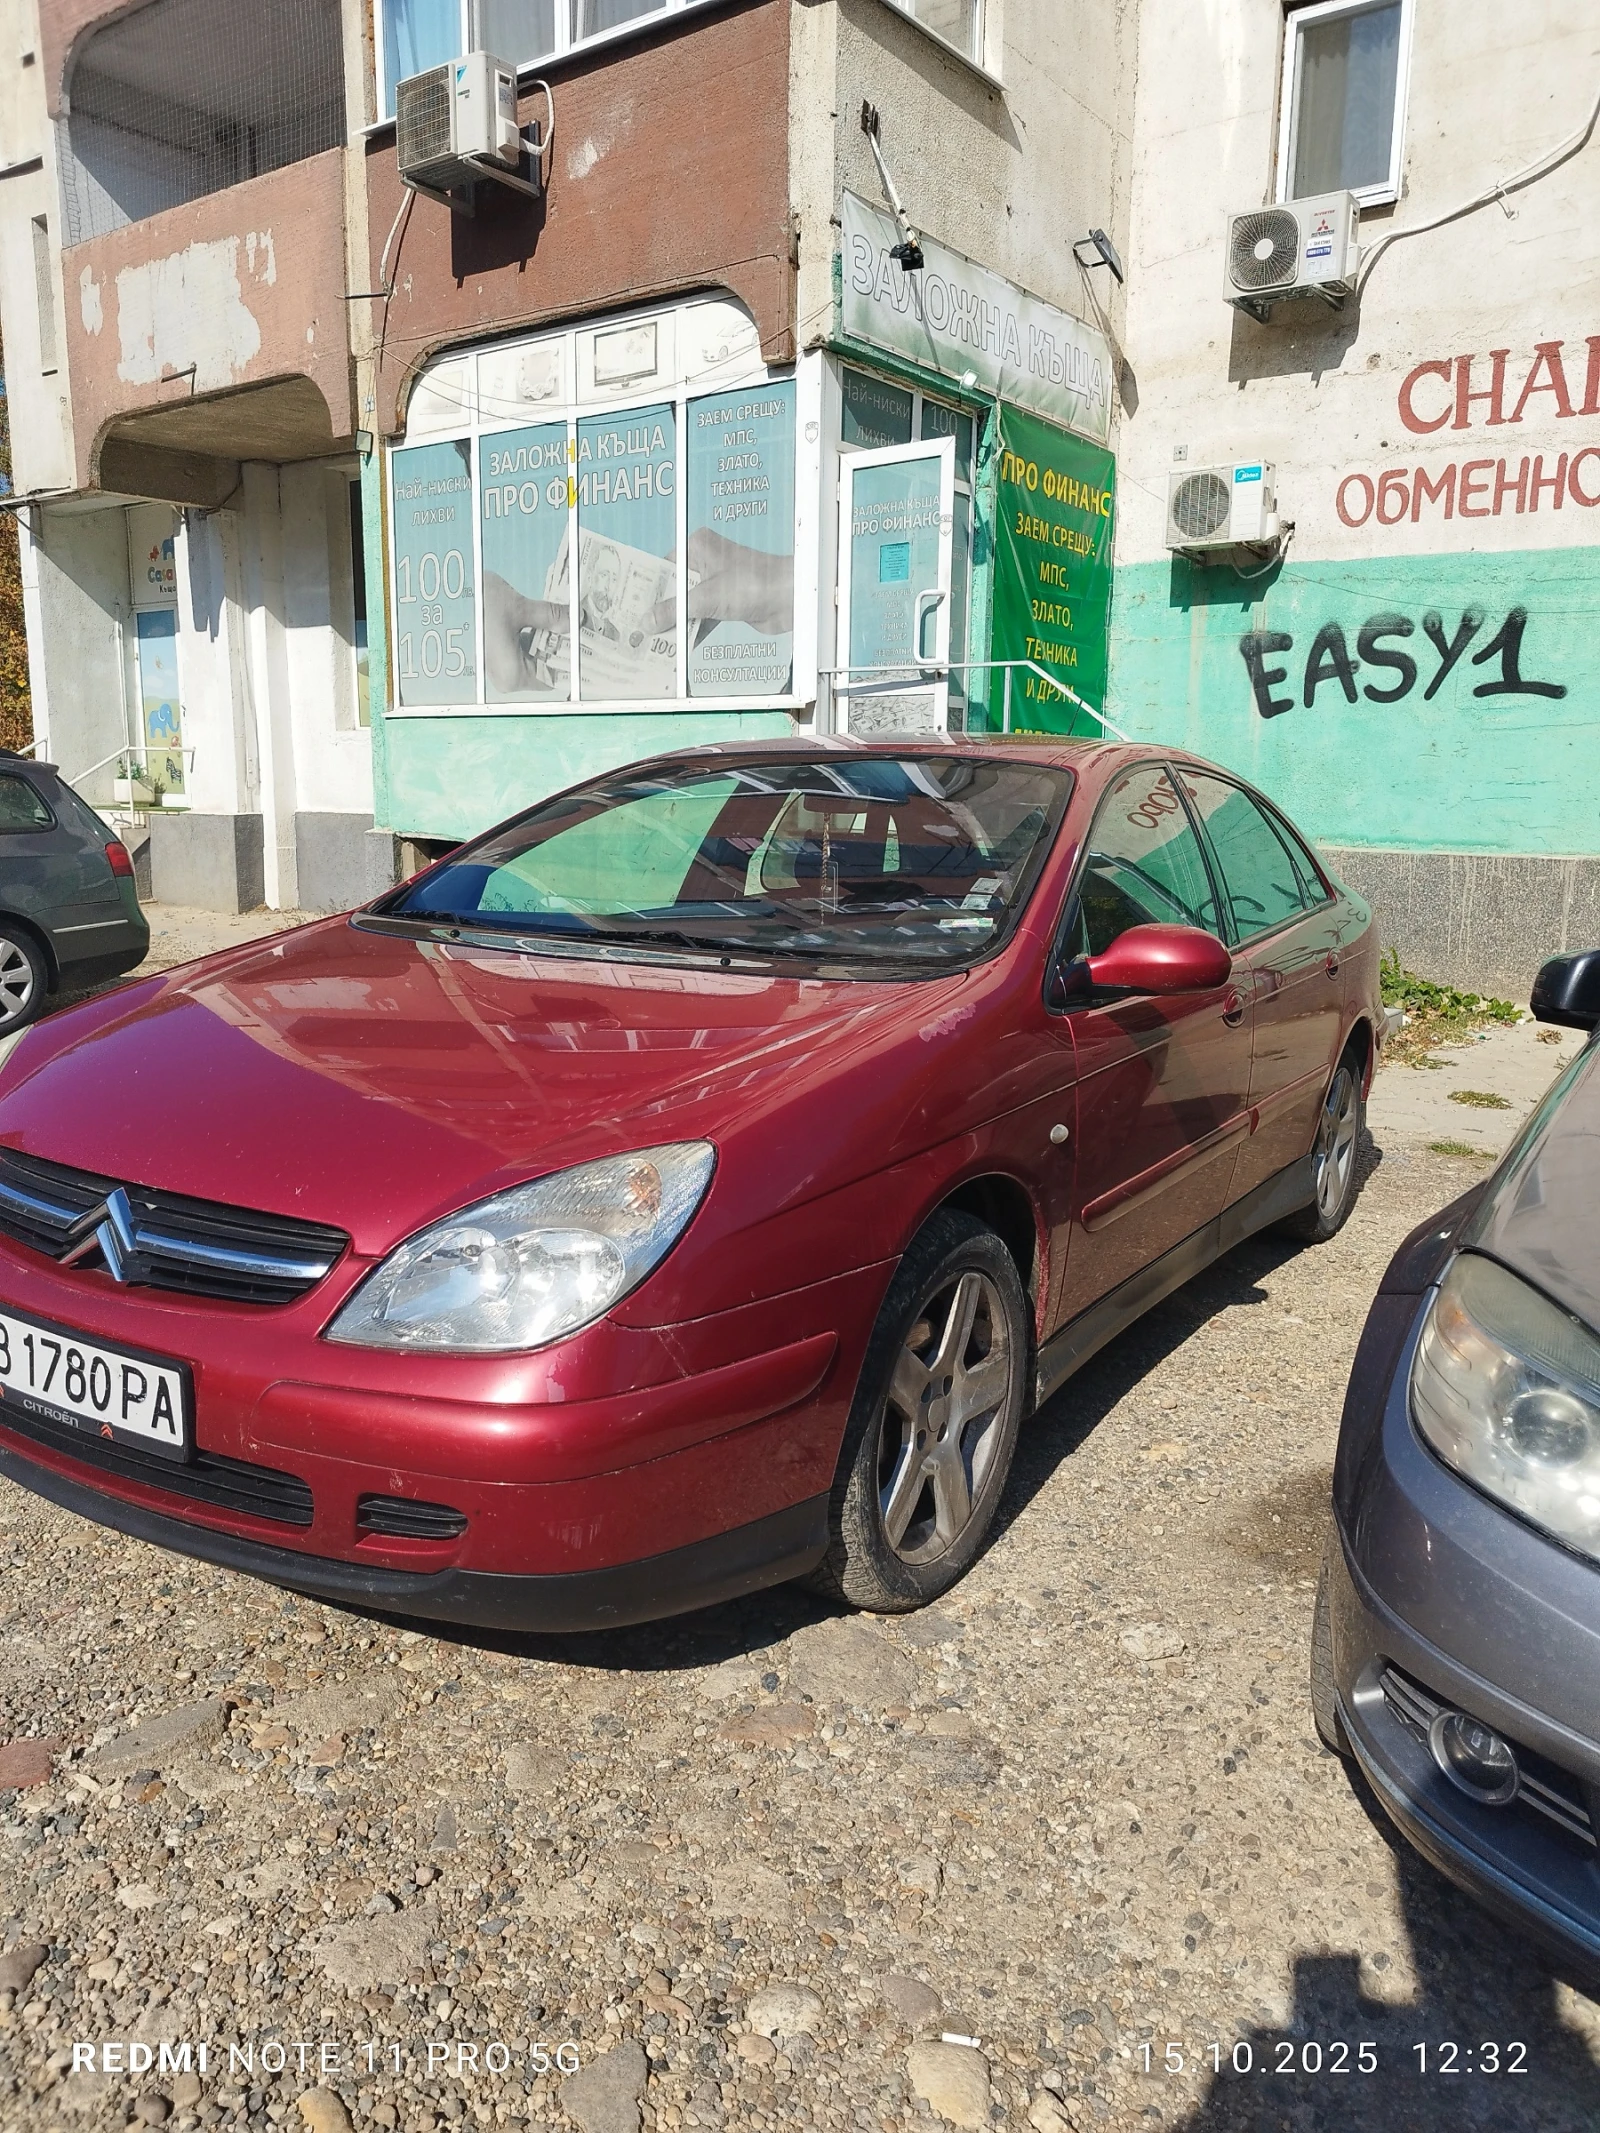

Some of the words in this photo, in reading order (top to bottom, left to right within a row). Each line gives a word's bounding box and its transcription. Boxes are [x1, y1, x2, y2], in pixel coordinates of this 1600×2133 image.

[851, 234, 1022, 368] ЗАЛОЖНА
[1028, 324, 1105, 410] КЪЩА
[1398, 335, 1600, 434] CHA
[697, 408, 733, 428] ЗАЕМ
[736, 399, 786, 421] СРЕЩУ:
[489, 437, 593, 477] ЗАЛОЖНА
[597, 425, 666, 461] КЪЩА
[723, 428, 757, 448] МПС,
[718, 452, 763, 472] ЗЛАТО,
[394, 476, 471, 501] Най-ниски
[484, 481, 539, 519] ПРО
[546, 460, 674, 510] ФИНАНС
[711, 475, 770, 497] ТЕХНИКА
[1002, 451, 1038, 492] ПРО
[1043, 468, 1112, 518] ФИНАНС
[412, 506, 455, 527] лихви
[713, 506, 722, 521] И
[725, 499, 768, 522] ДРУГИ
[852, 500, 905, 518] ЗАЛОЖНА
[852, 519, 879, 536] ПРО
[882, 510, 941, 534] ФИНАНС
[1015, 512, 1049, 543] ЗАЕМ
[1052, 525, 1096, 559] СРЕЩУ:
[398, 549, 465, 604] 100
[1040, 561, 1069, 591] МПС,
[421, 604, 443, 626] за
[1031, 599, 1074, 631] ЗЛАТО,
[702, 642, 777, 661] БЕЗПЛАТНИ
[1026, 637, 1078, 667] ТЕХНИКА
[1240, 603, 1567, 720] EASY1
[693, 665, 787, 683] КОНСУЛТАЦИИ
[1026, 677, 1035, 698] И
